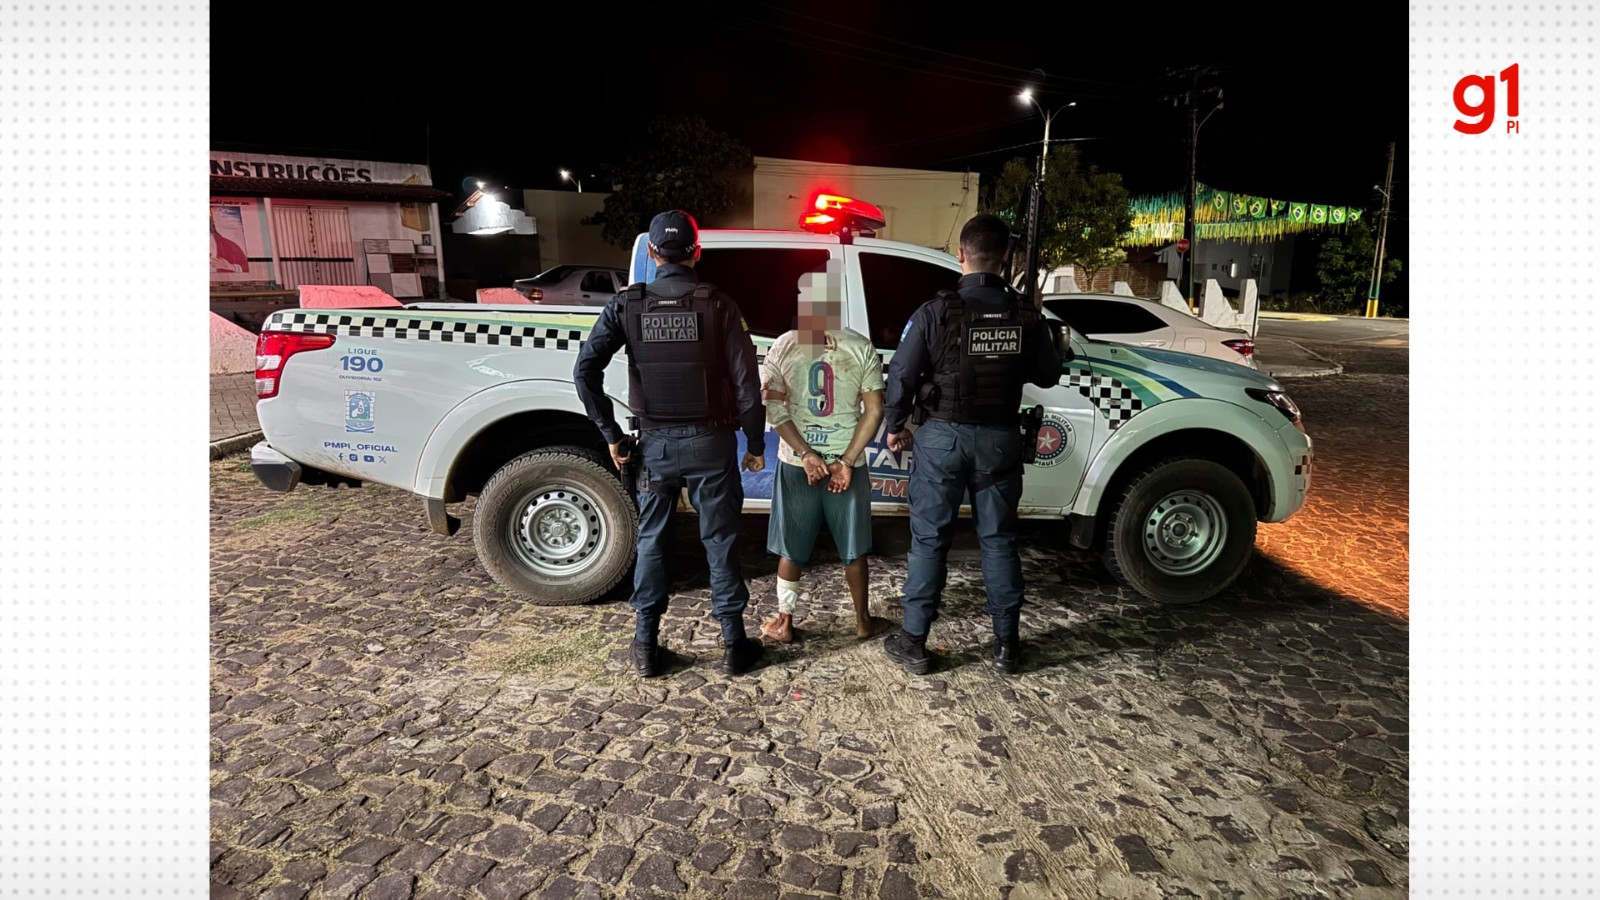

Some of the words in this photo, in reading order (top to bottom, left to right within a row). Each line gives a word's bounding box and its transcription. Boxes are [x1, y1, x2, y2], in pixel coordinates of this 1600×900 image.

[643, 314, 695, 328] POLÍCIA
[642, 328, 695, 341] MILITAR
[972, 328, 1018, 341] POLÍCIA
[971, 341, 1017, 352] MILITAR
[340, 356, 383, 372] 190
[808, 361, 834, 417] 9
[1051, 414, 1073, 433] MILITAR
[324, 441, 398, 452] PMPI_OFICIAL
